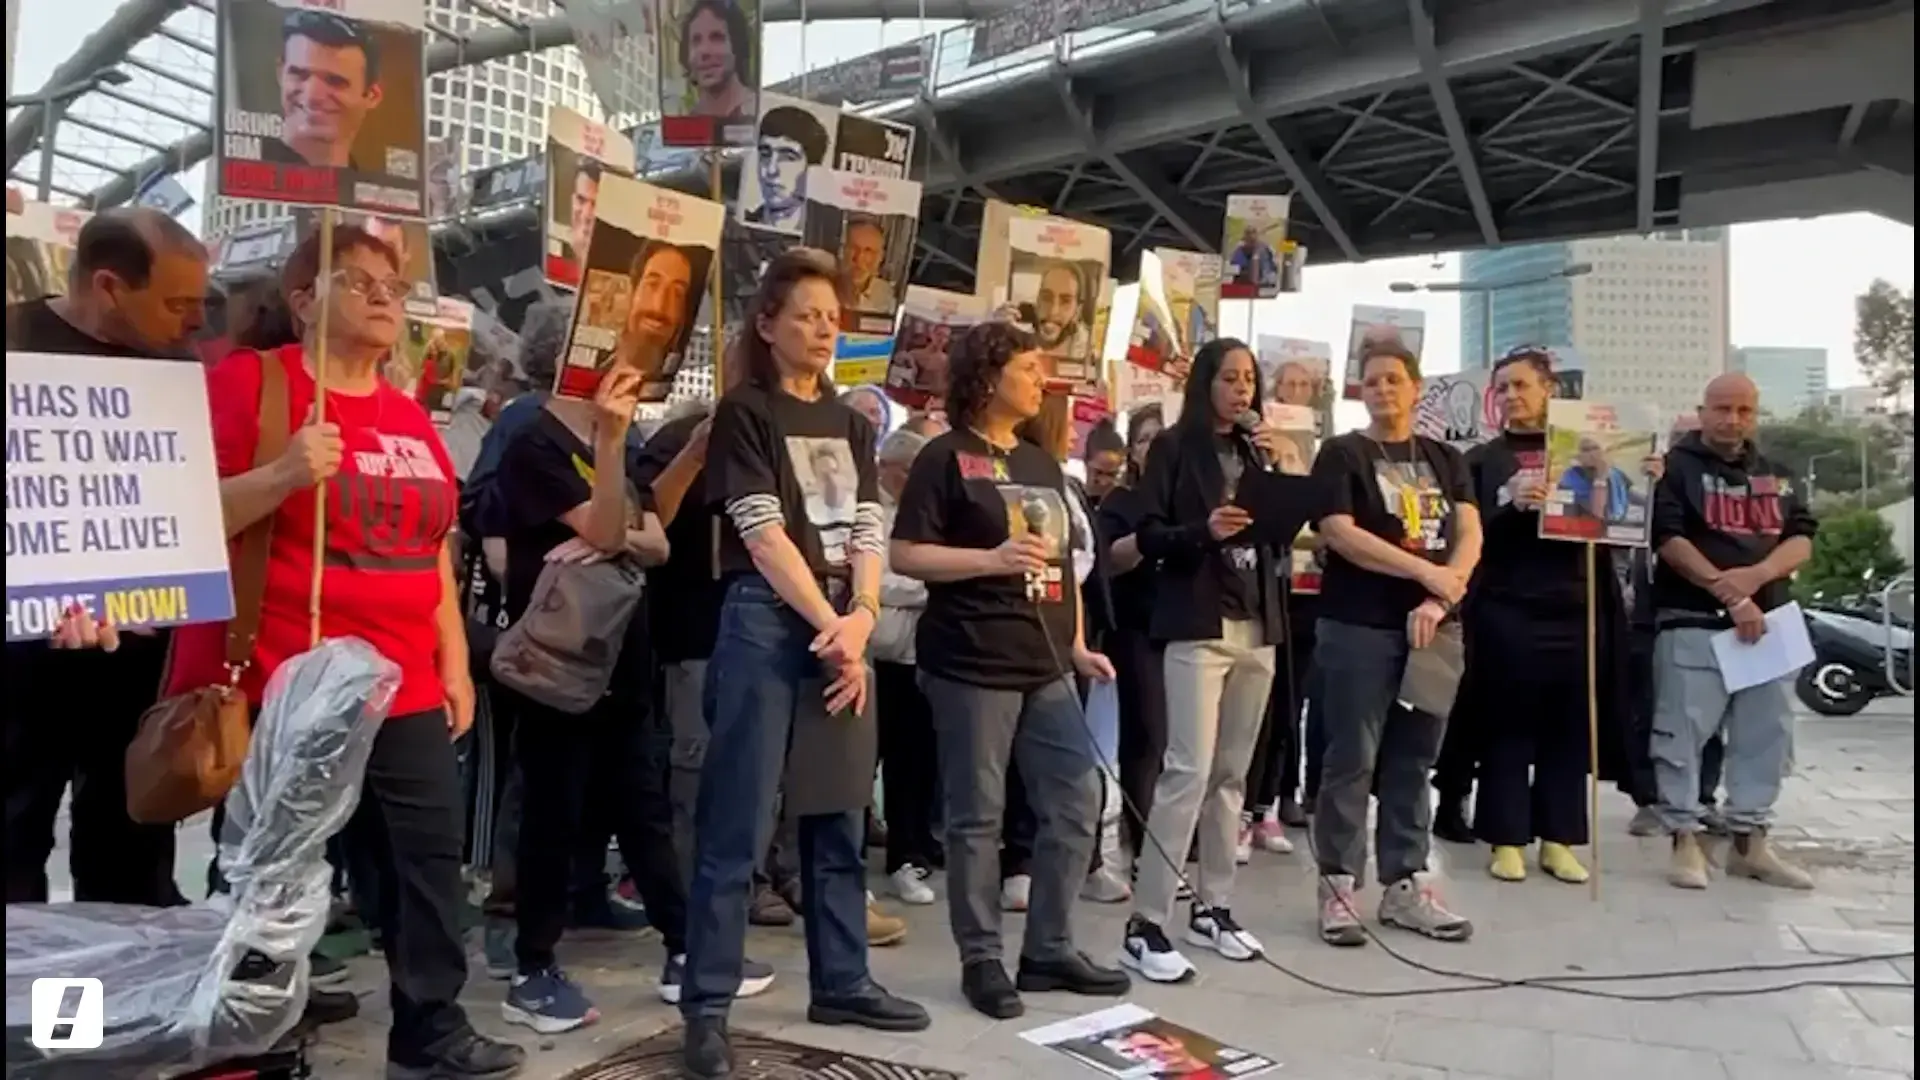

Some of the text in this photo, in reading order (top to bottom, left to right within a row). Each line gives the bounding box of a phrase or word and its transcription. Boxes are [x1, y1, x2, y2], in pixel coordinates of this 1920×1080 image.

[884, 129, 907, 162] אל
[10, 384, 130, 419] HAS NO
[52, 430, 93, 463] TO
[102, 431, 186, 463] WAIT.
[6, 473, 140, 509] ING HIM
[82, 516, 180, 552] ALIVE!
[104, 587, 189, 626] NOW!
